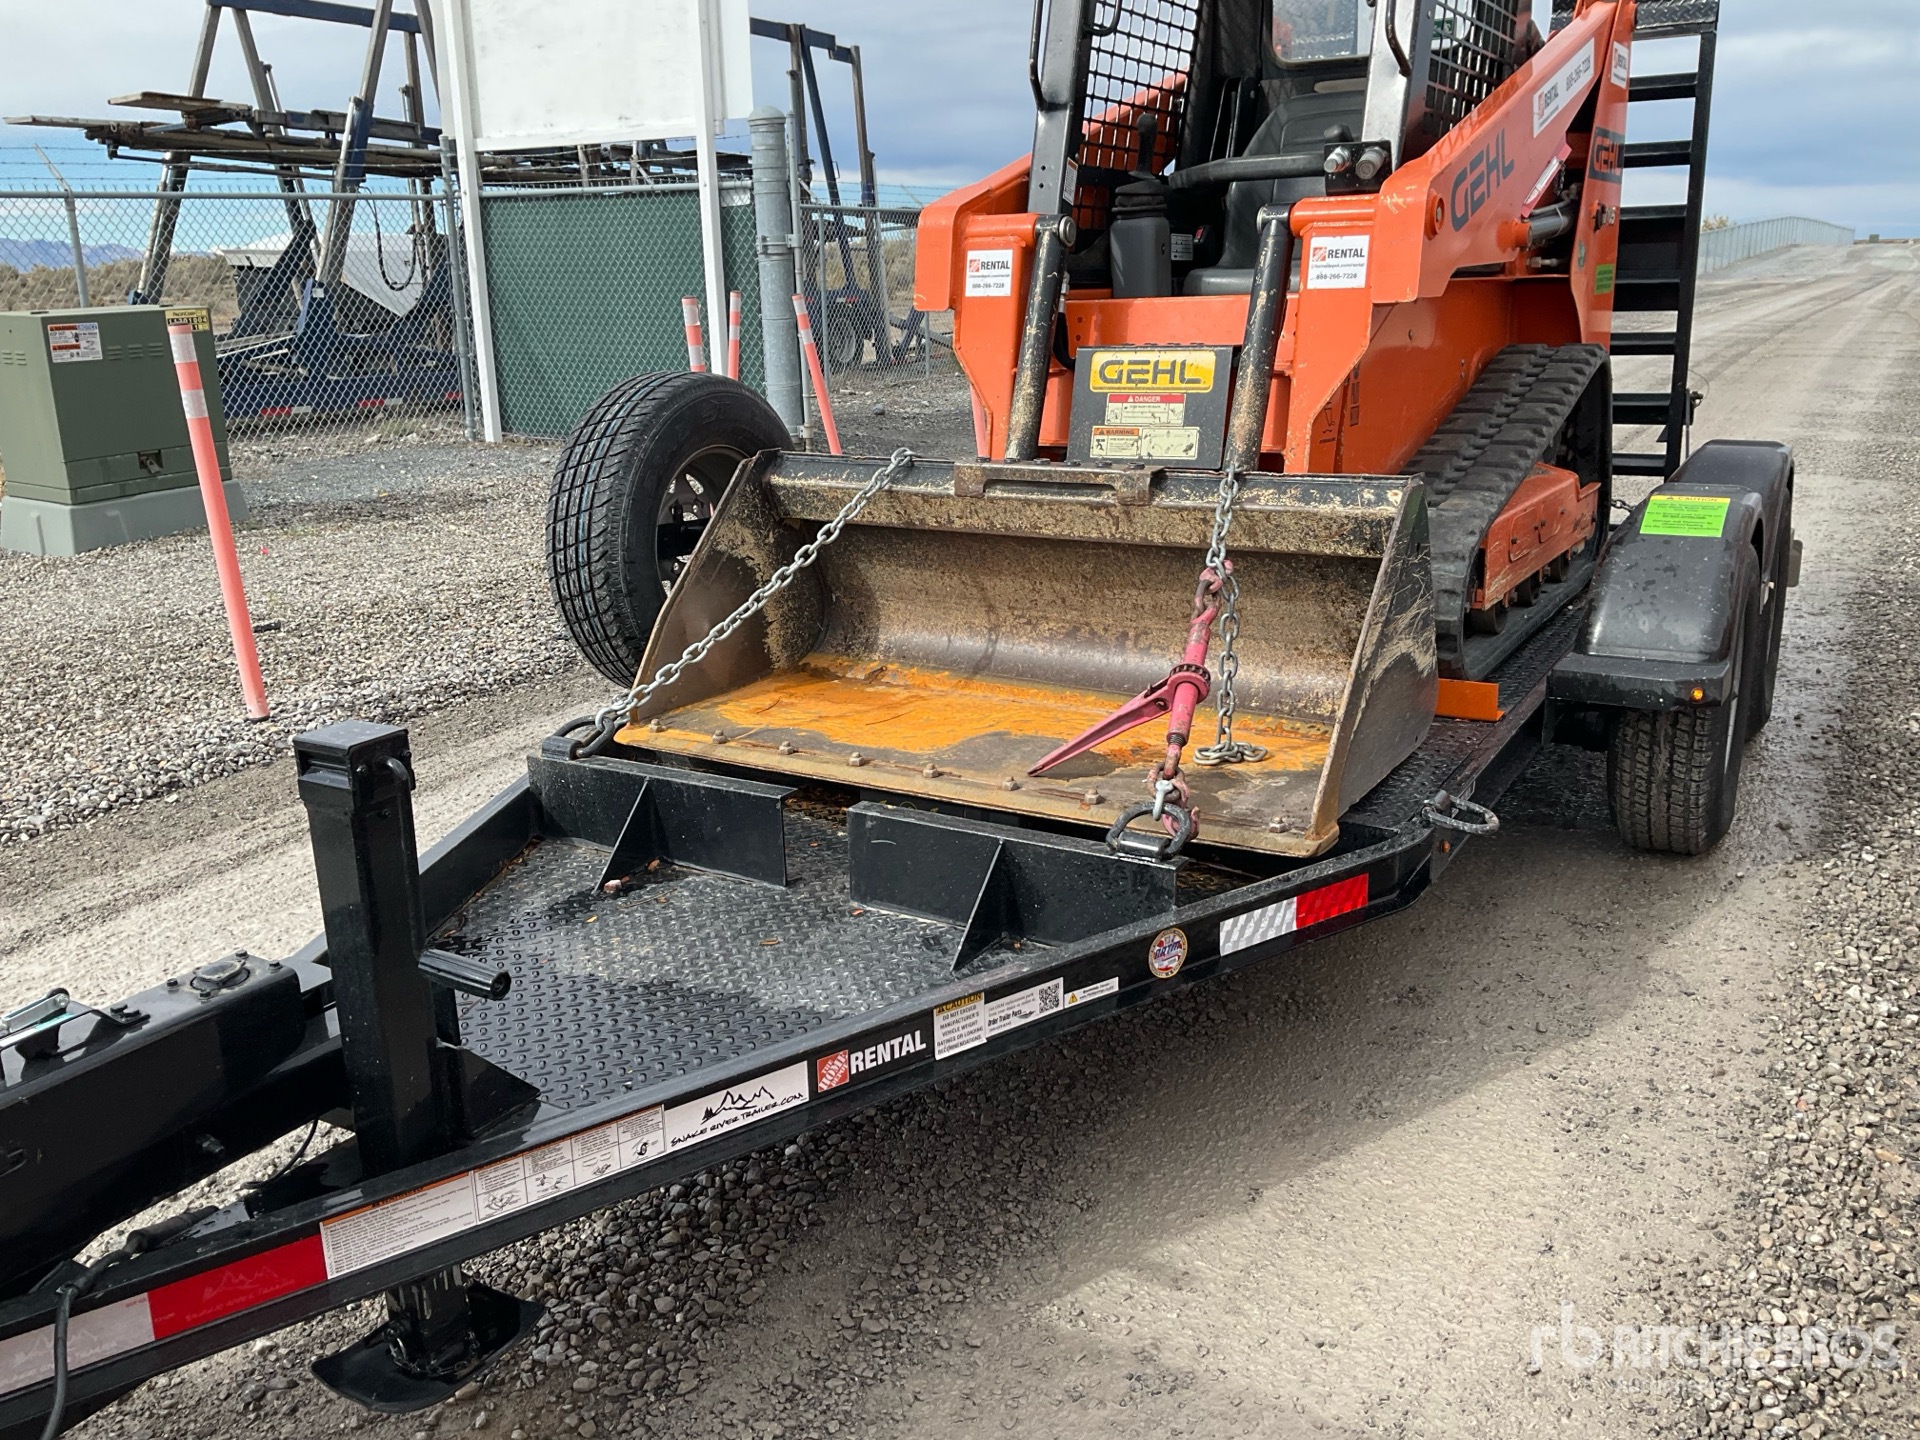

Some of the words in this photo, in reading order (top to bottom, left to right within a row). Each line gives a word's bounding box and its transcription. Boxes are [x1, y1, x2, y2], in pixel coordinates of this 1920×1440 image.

[1451, 128, 1514, 232] GEHL
[980, 260, 1010, 270] RENTAL
[1328, 248, 1365, 258] RENTAL
[1099, 360, 1202, 384] GEHL
[946, 994, 982, 1010] CAUTION
[999, 1013, 1012, 1023] Trailer
[850, 1030, 926, 1074] RENTAL
[818, 1051, 848, 1090] HOME
[670, 1127, 708, 1147] SNAKE
[710, 1116, 739, 1132] RIVER
[741, 1092, 804, 1120] TRAILER.COM
